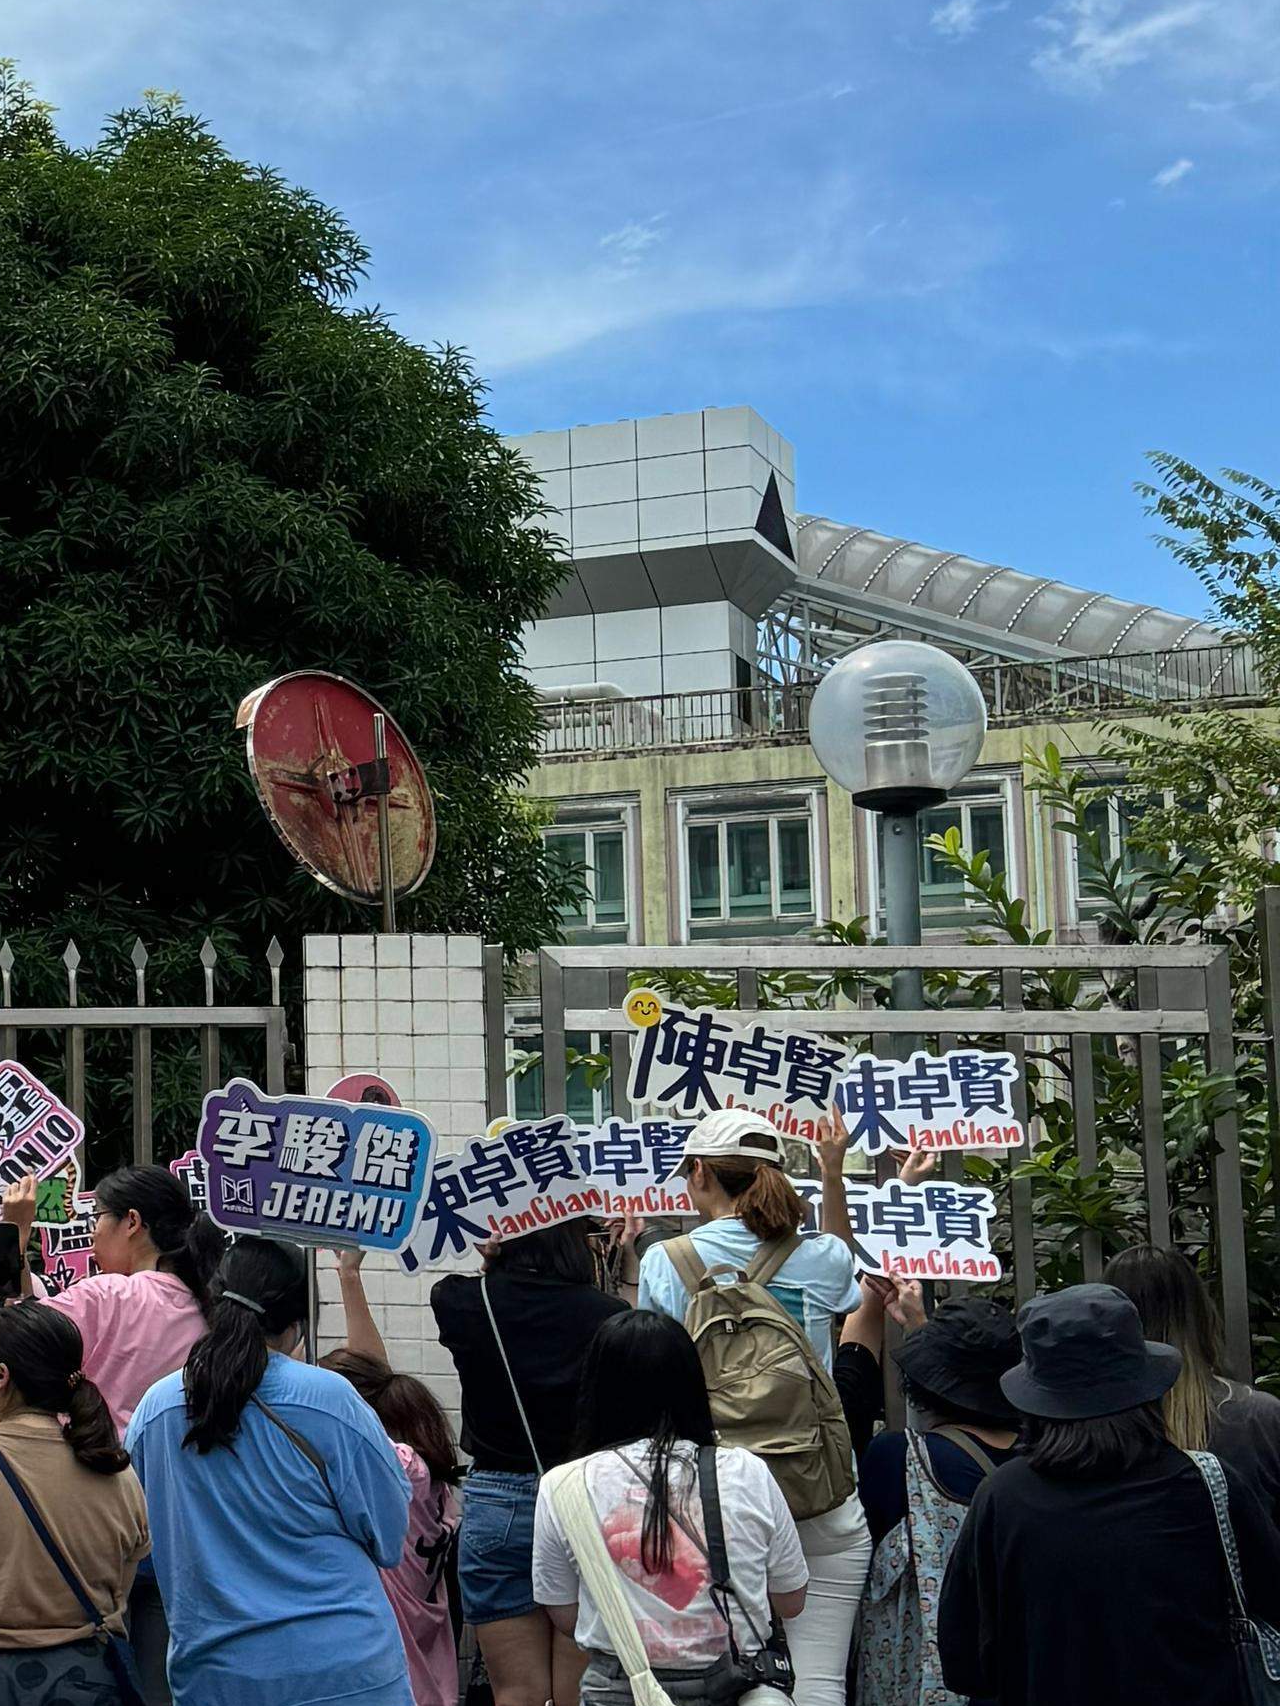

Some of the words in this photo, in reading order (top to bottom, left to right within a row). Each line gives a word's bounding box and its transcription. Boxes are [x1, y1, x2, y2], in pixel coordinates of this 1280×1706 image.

[633, 1007, 847, 1112] 陳卓賢
[213, 1108, 418, 1191] 李駿傑
[575, 1121, 698, 1186] 卓賢
[262, 1181, 403, 1235] JEREMY
